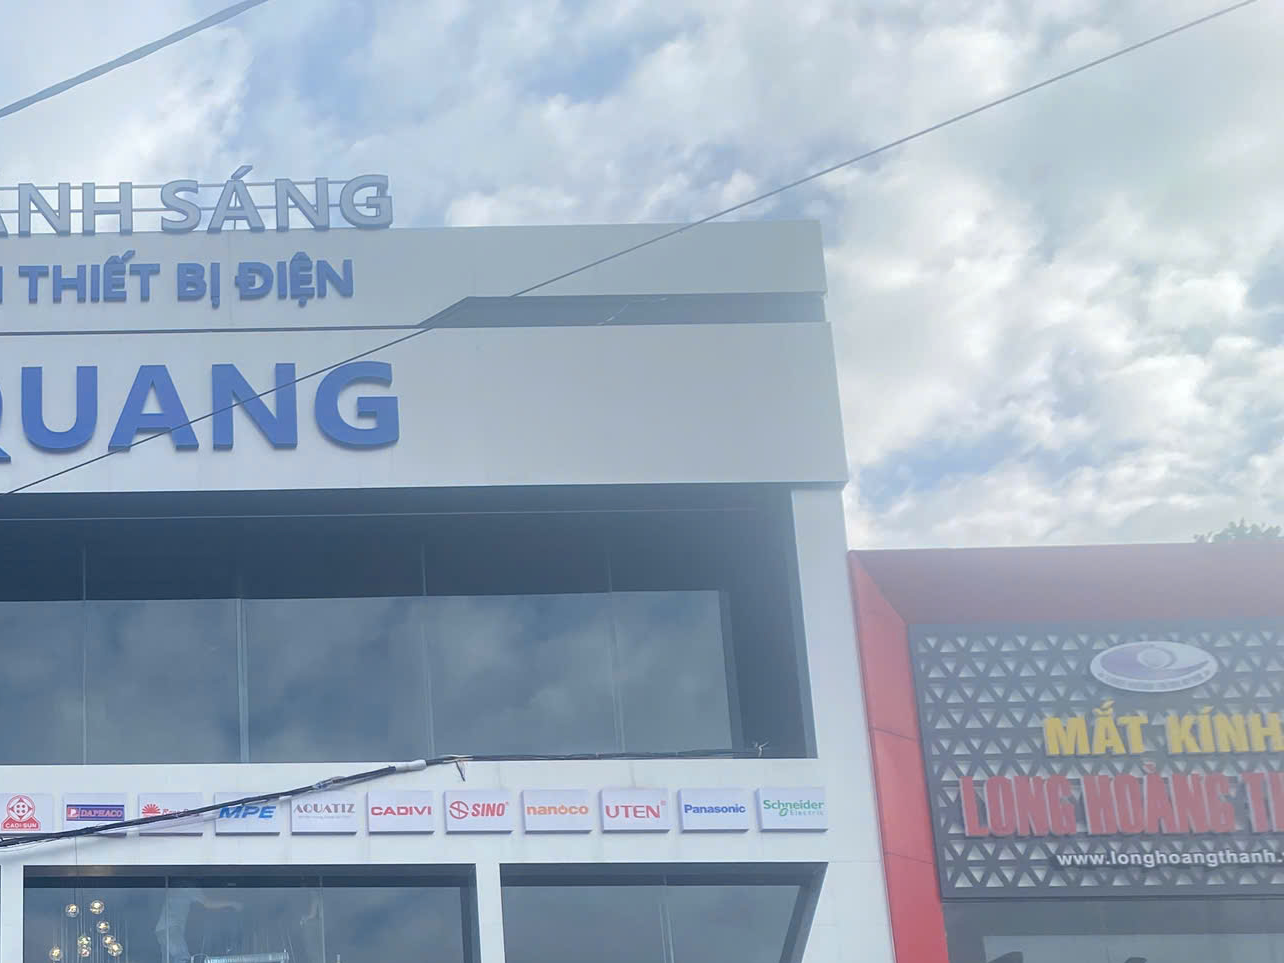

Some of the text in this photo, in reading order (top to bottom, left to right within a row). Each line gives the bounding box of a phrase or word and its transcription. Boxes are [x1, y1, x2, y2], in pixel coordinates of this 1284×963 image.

[160, 165, 393, 233] SÁNG
[19, 250, 161, 304] THIẾT
[176, 261, 222, 309] BỊ
[234, 251, 354, 308] ĐIỆN
[1043, 697, 1284, 757] MẮT KÍNH
[294, 803, 355, 814] AQUATIZ
[370, 805, 432, 816] CADIVI
[471, 802, 506, 817] SINO
[683, 803, 746, 814] Panasonic
[763, 799, 825, 810] Schneider
[960, 775, 1078, 837] LONG
[219, 805, 276, 819] MPE
[605, 805, 661, 819] UTEN
